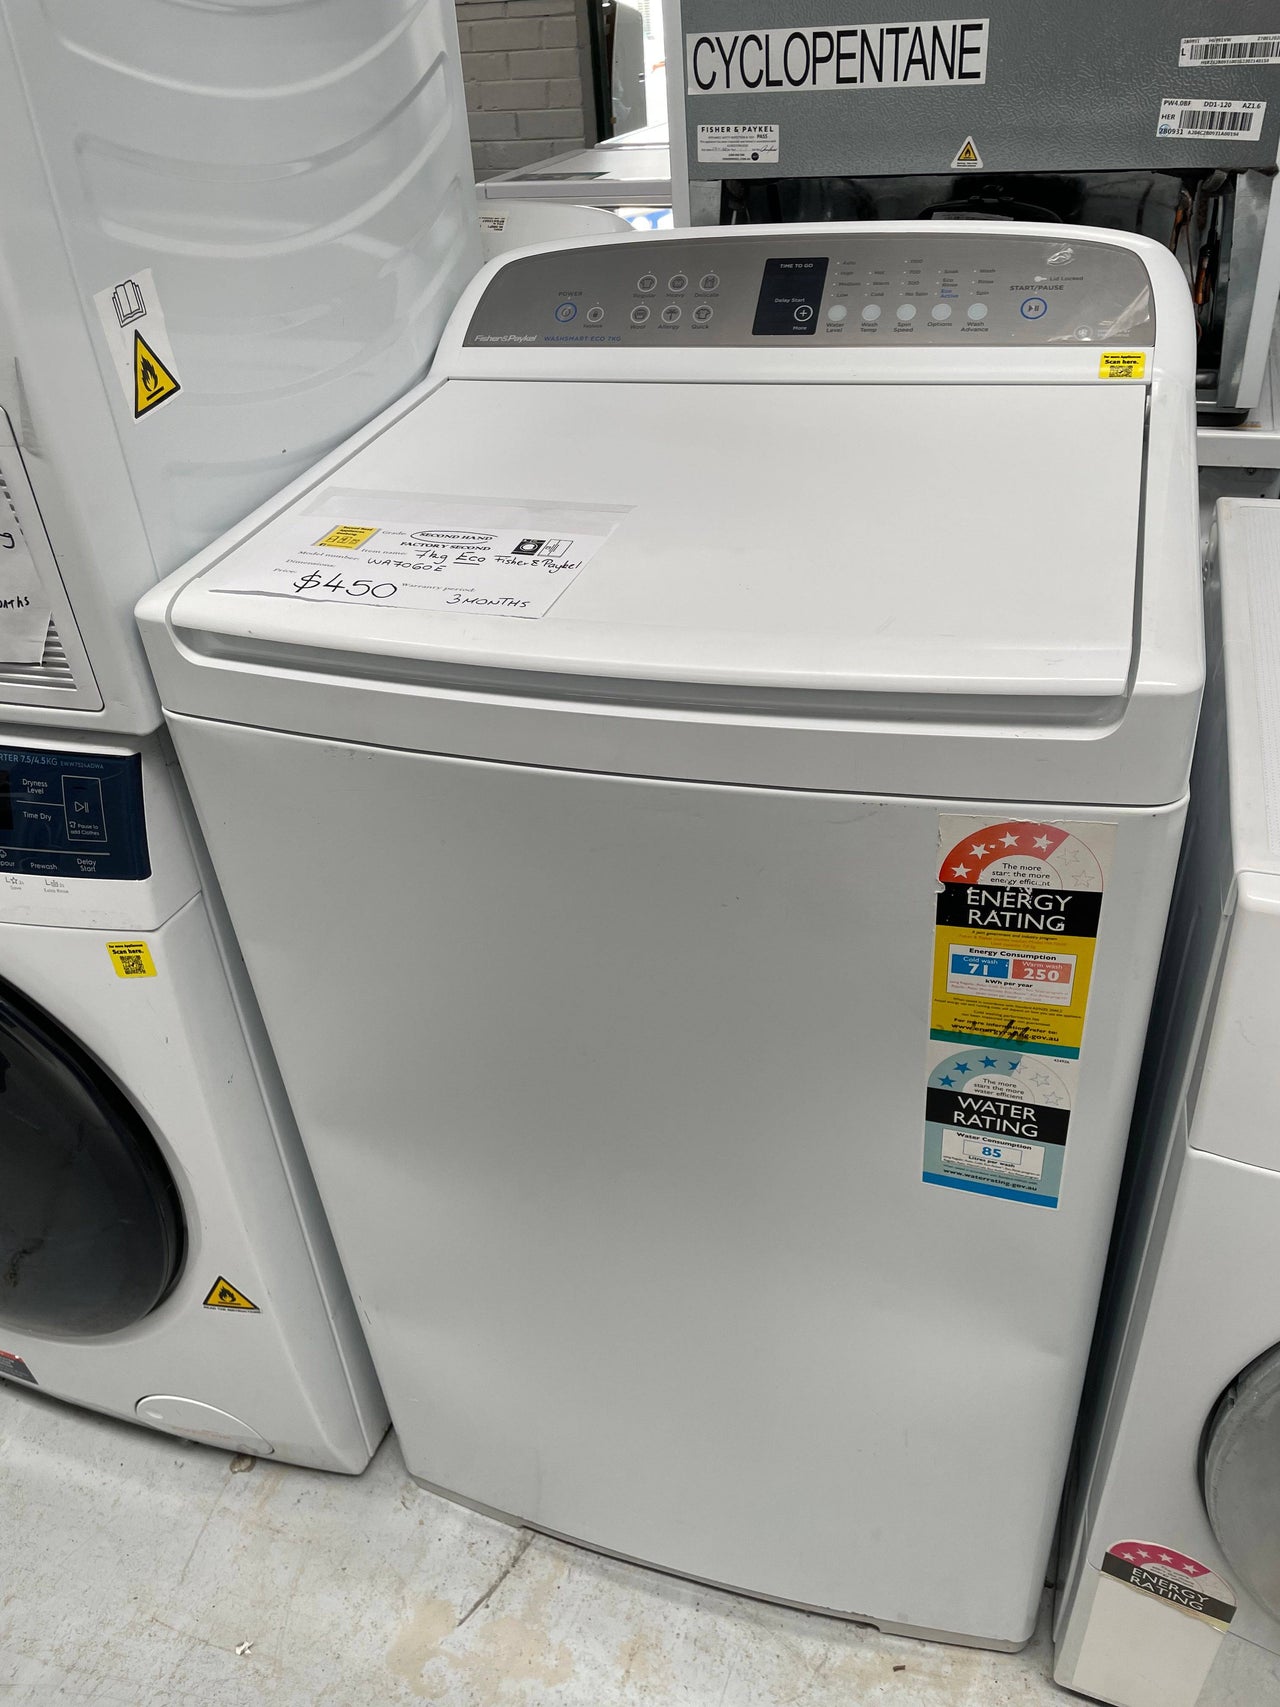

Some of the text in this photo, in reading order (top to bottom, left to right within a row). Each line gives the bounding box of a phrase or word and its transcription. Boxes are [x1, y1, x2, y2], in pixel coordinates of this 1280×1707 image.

[692, 22, 984, 90] CYCLOPENTANE
[1181, 48, 1186, 56] L
[367, 557, 447, 572] WA7060E
[414, 549, 448, 565] 7kg
[455, 551, 486, 562] Eco
[494, 555, 526, 566] Fisher
[542, 559, 583, 574] Paykel
[293, 570, 397, 599] $450
[402, 582, 441, 591] Warranty
[20, 755, 58, 766] 7.5/4.5KG
[22, 779, 48, 788] Dryness
[27, 786, 44, 794] Level
[40, 813, 52, 821] Dry
[77, 858, 96, 866] Delay
[968, 890, 1073, 912] ENERGY
[968, 909, 1066, 932] RATING
[969, 948, 1057, 960] Energy Consumption
[968, 963, 989, 975] 71
[1023, 968, 1059, 981] 250
[996, 1091, 1023, 1100] efficient
[957, 1095, 1036, 1121] WATER
[954, 1111, 1038, 1137] RATING
[957, 1132, 1032, 1150] Water Consumption
[982, 1146, 1001, 1158] 85
[944, 1169, 1038, 1191] www.waterrating.gov.au
[1133, 1568, 1209, 1602] ENERGY
[1130, 1575, 1203, 1611] RATING
